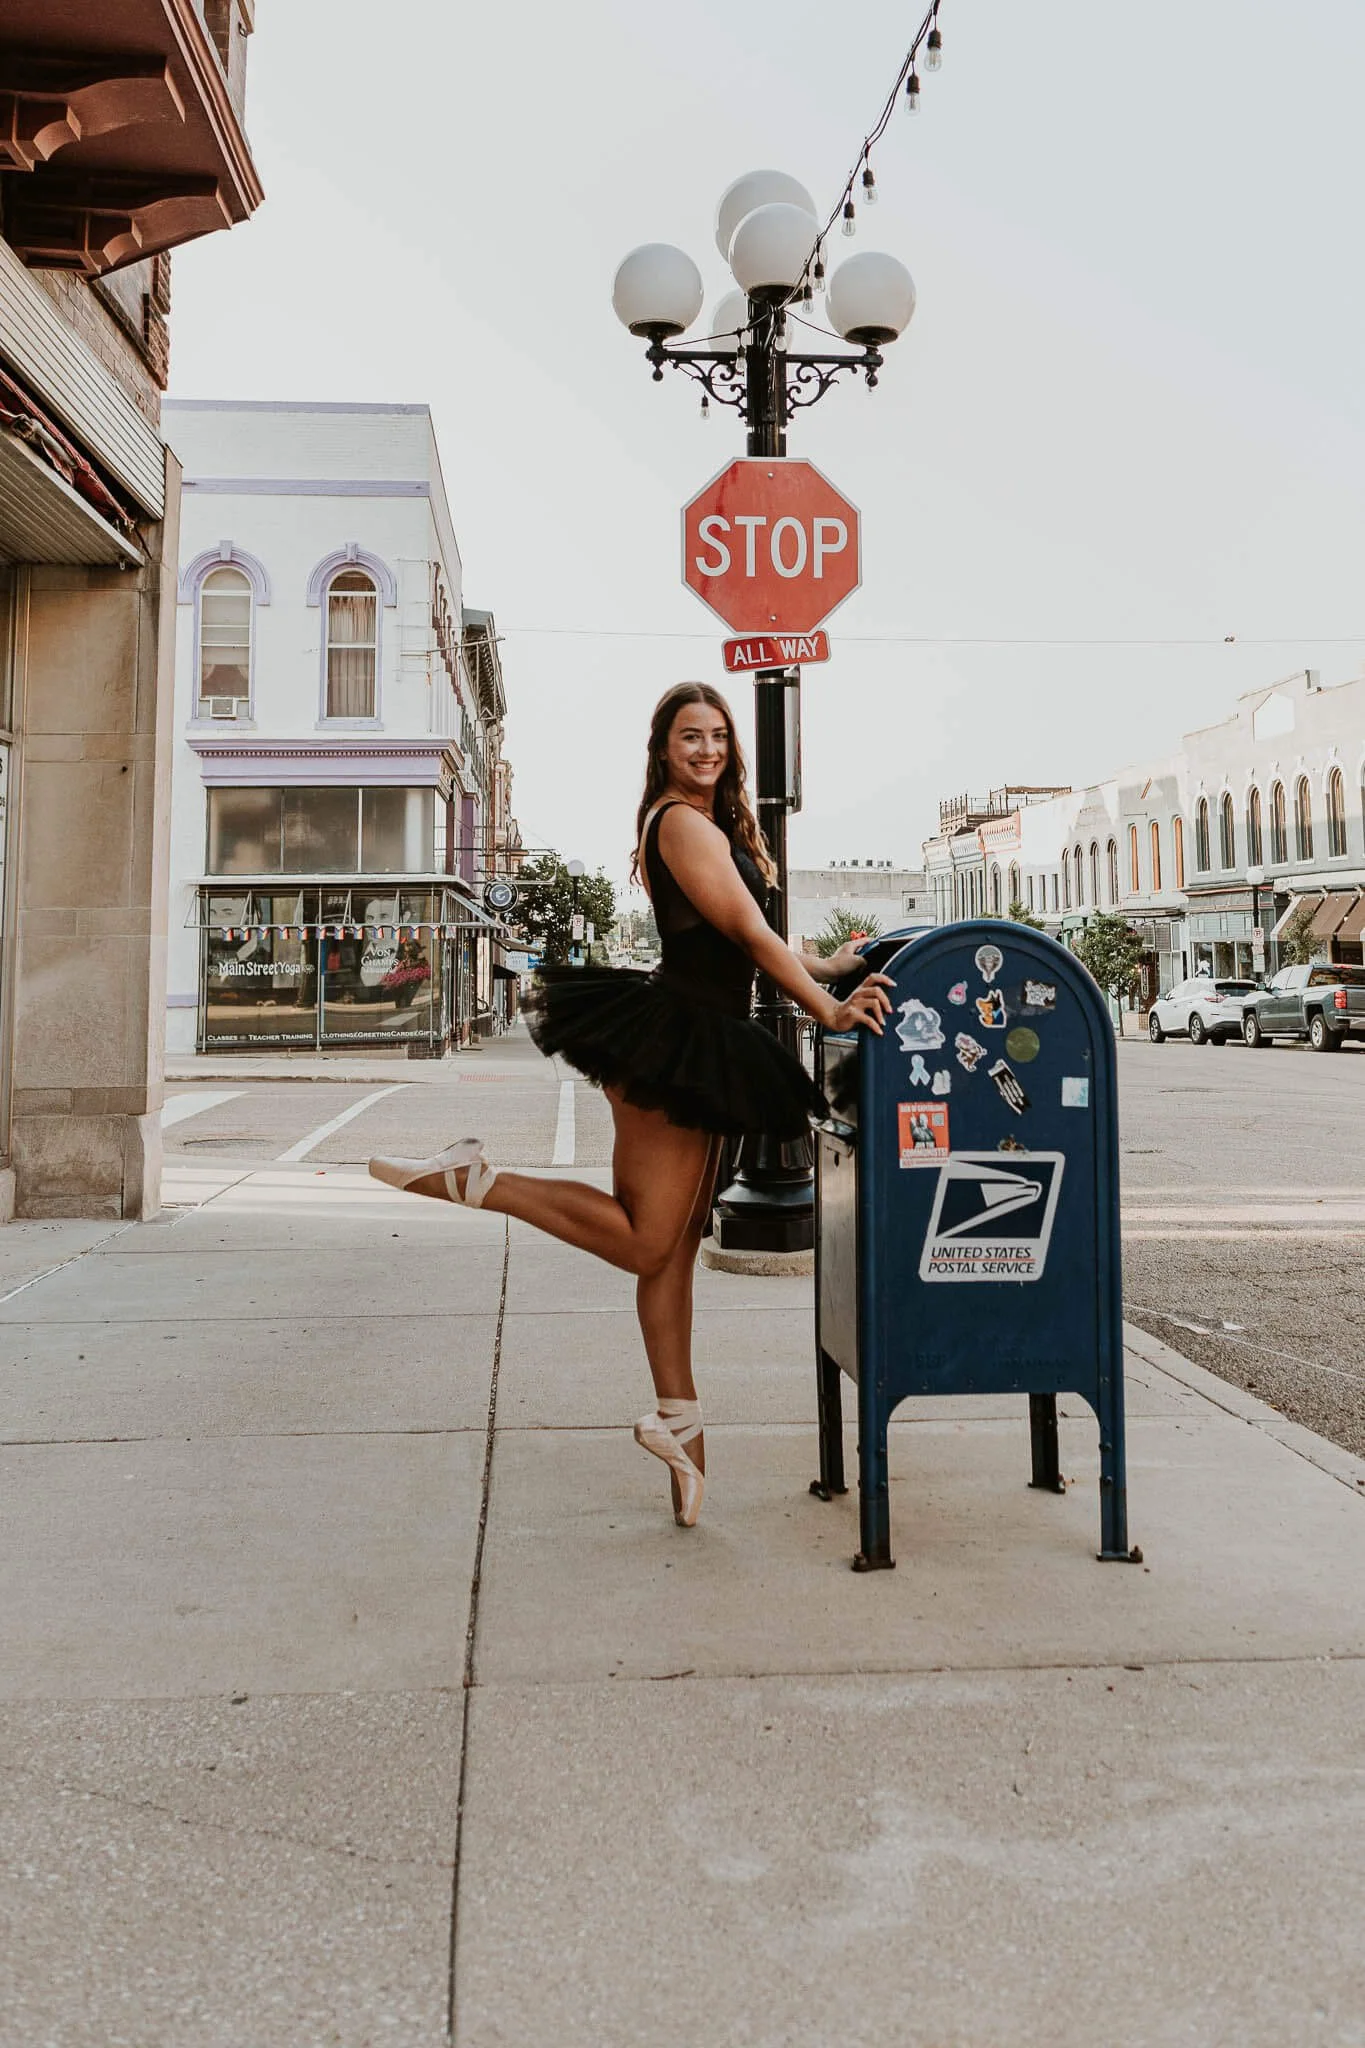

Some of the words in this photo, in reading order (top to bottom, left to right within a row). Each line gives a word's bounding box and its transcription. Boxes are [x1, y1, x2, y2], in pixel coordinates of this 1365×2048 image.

[695, 514, 848, 579] STOP
[733, 643, 773, 666] ALL
[779, 636, 821, 660] WAY
[218, 961, 245, 976] Main
[246, 961, 279, 976] Street
[278, 961, 301, 975] Yoga
[931, 1247, 982, 1258] UNITED
[984, 1247, 1032, 1259] STATES
[928, 1262, 978, 1273] POSTAL
[981, 1262, 1036, 1273] SERVICE
